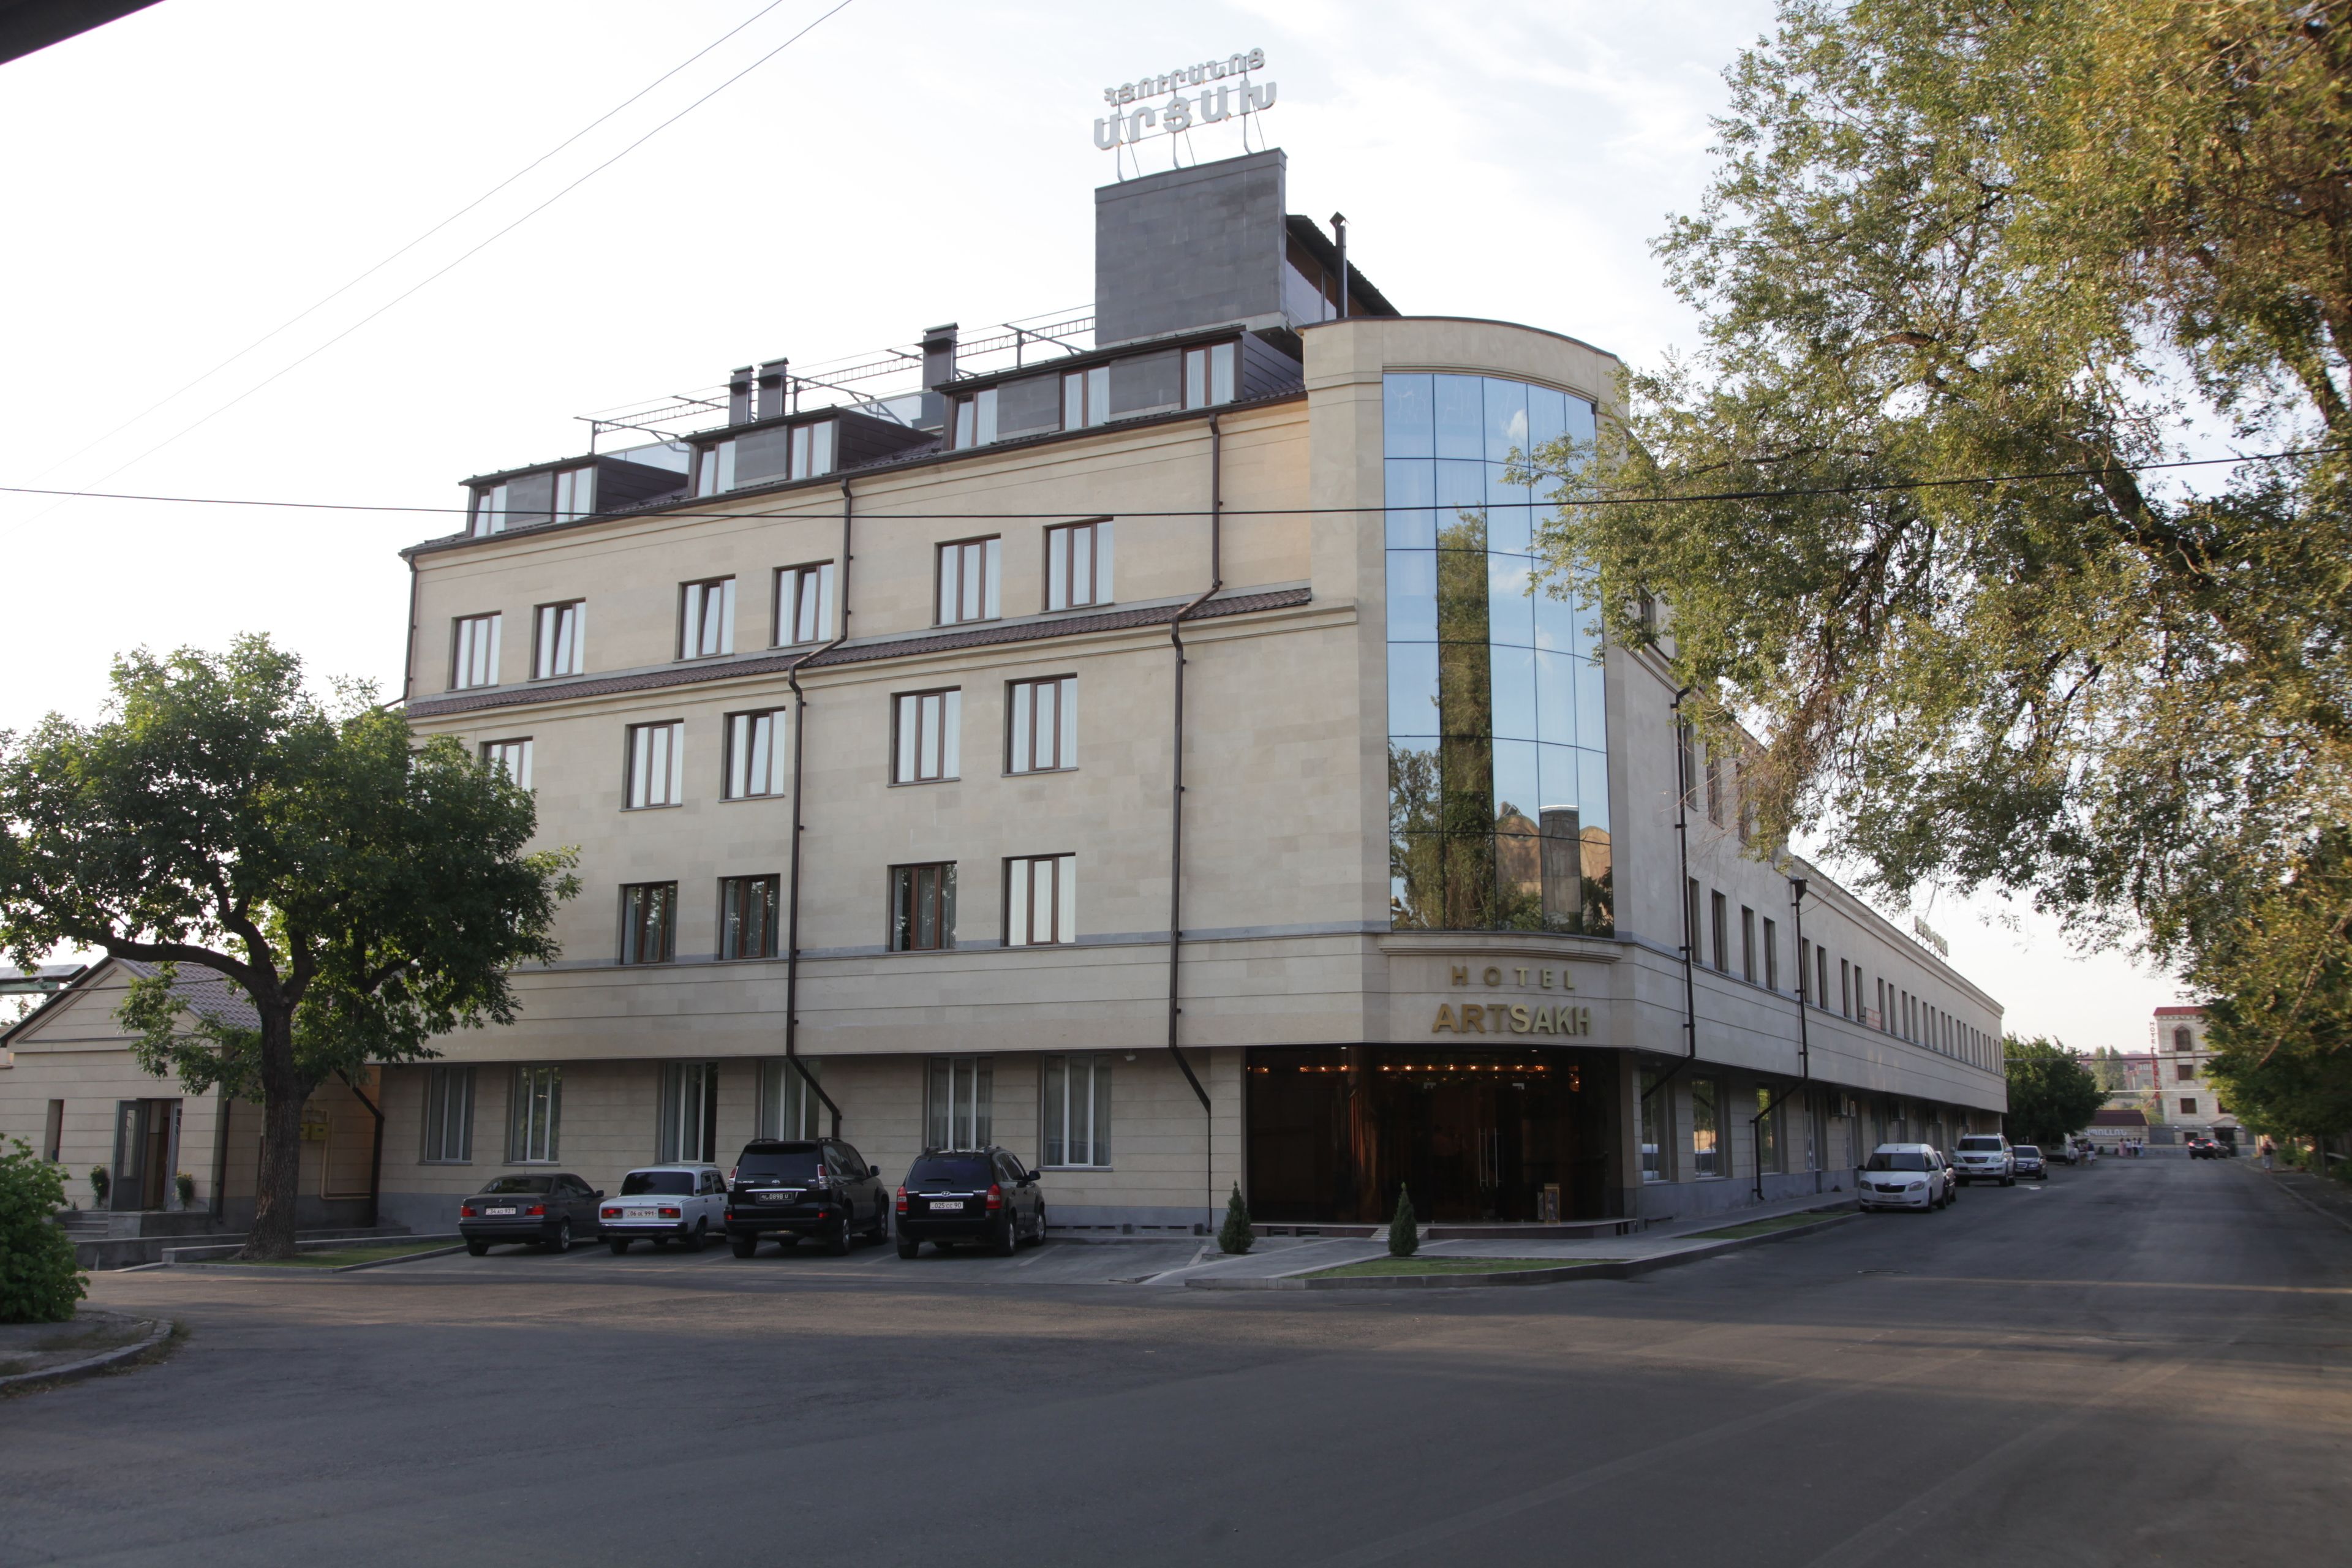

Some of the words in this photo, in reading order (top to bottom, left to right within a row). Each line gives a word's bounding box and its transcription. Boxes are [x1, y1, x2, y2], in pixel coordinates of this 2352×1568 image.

[1104, 47, 1265, 107] ՀՅՈՒՐԱՆՈՑ
[1094, 80, 1277, 151] ԱՐՑԱԽ
[1451, 965, 1576, 990] HOTEL
[1431, 1003, 1592, 1036] ARTSAKH
